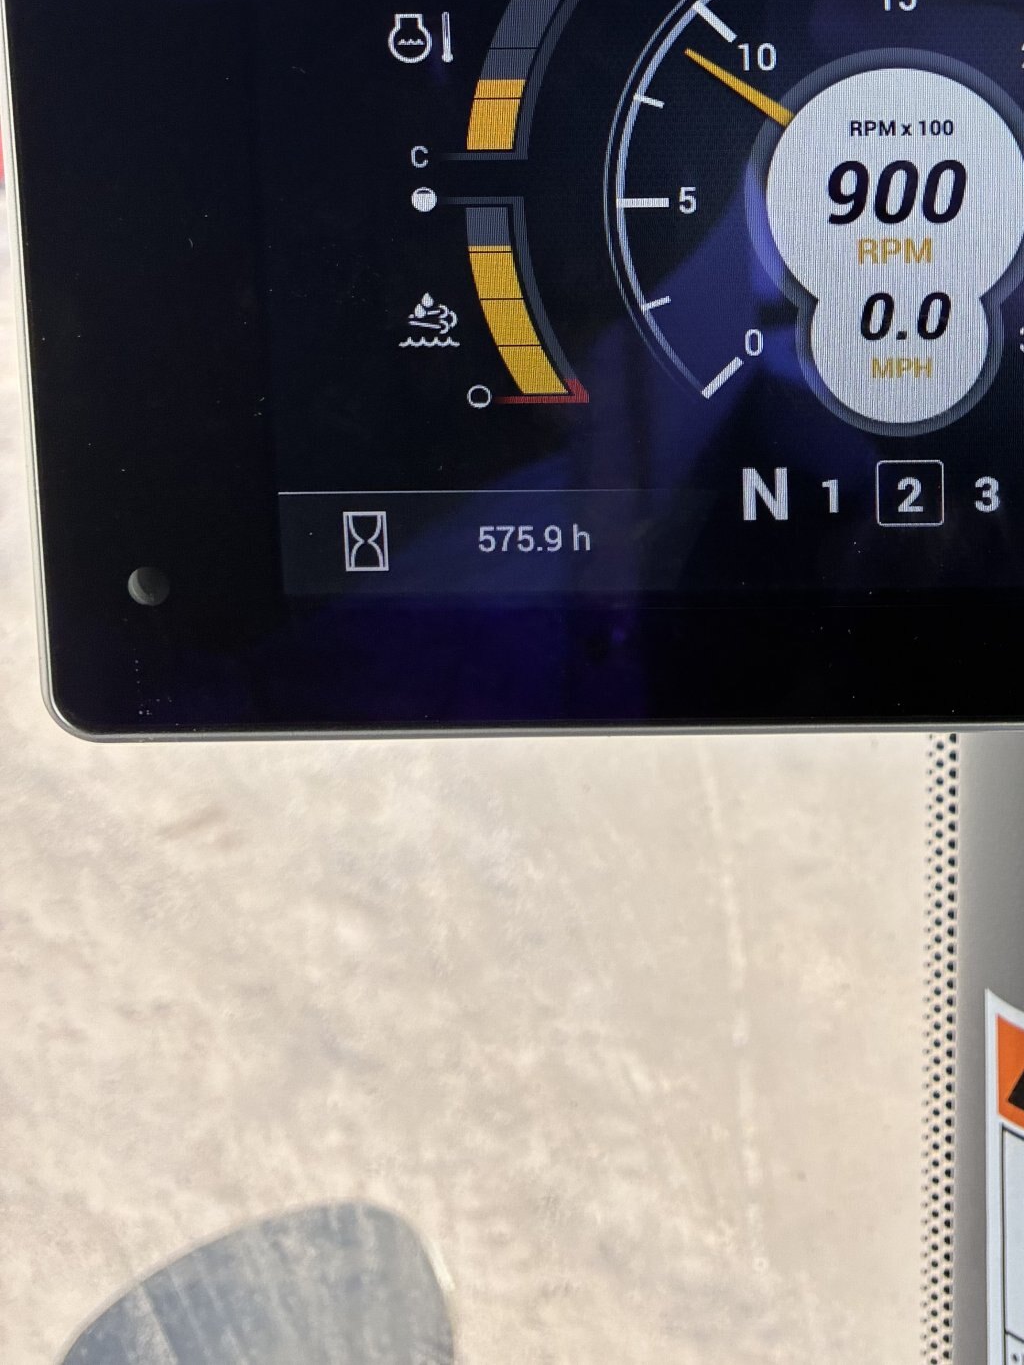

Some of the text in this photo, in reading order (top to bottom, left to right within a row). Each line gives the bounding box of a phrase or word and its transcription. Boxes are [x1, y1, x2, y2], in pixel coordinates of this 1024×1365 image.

[738, 42, 778, 72] 10
[849, 119, 955, 137] RPM x 100
[410, 145, 429, 169] C
[679, 187, 697, 214] 5
[827, 159, 967, 226] 900
[857, 237, 932, 265] RPM
[860, 291, 952, 342] 0.0
[744, 329, 765, 357] 0
[870, 357, 932, 378] MPH
[742, 467, 790, 521] N
[821, 478, 839, 514] 1
[897, 477, 924, 513] 2
[974, 476, 1001, 513] 3
[478, 523, 592, 553] 575.9 h
